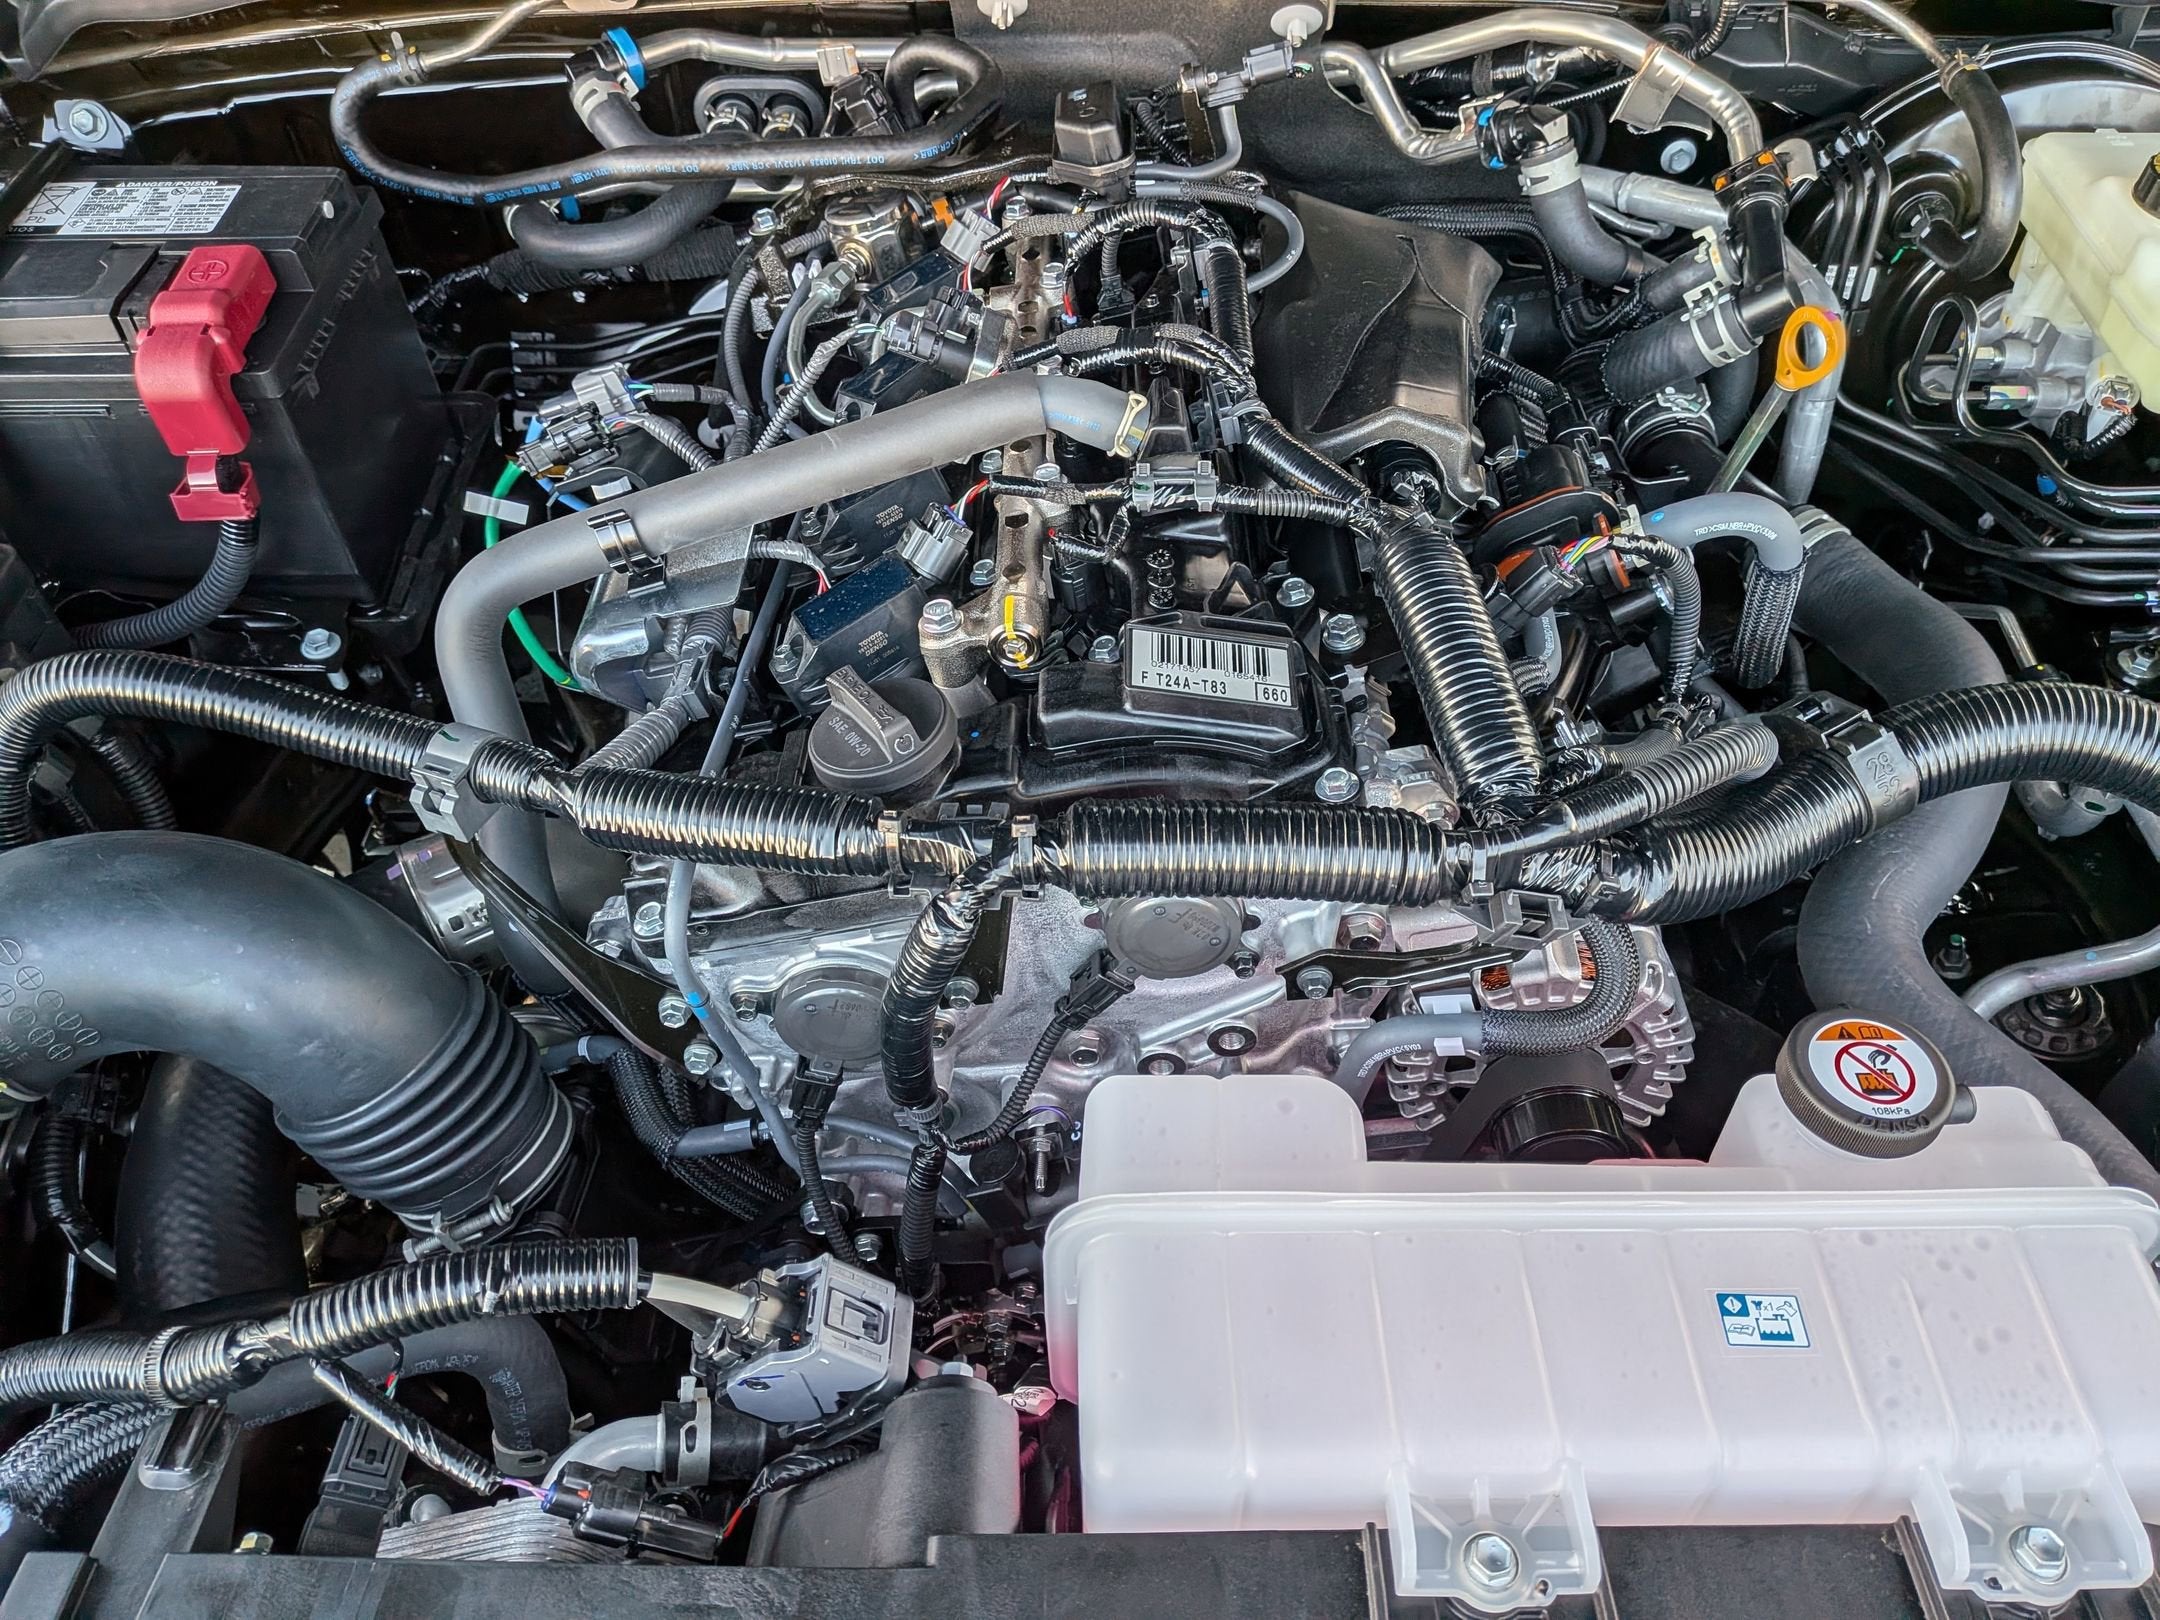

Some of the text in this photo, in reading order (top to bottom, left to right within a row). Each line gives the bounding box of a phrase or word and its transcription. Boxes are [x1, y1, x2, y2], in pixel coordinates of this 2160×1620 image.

[866, 154, 885, 164] DOT
[875, 504, 900, 518] TOYOTA
[881, 512, 903, 528] DENSO
[858, 630, 884, 647] TOYOTA
[865, 639, 888, 657] DENSO
[1141, 671, 1288, 703] F T24A-T83 660
[828, 716, 872, 757] SAE 0W-20
[1871, 1107, 1911, 1115] 108kPa
[1856, 1115, 1930, 1133] DENSO
[1763, 1302, 1774, 1312] x1
